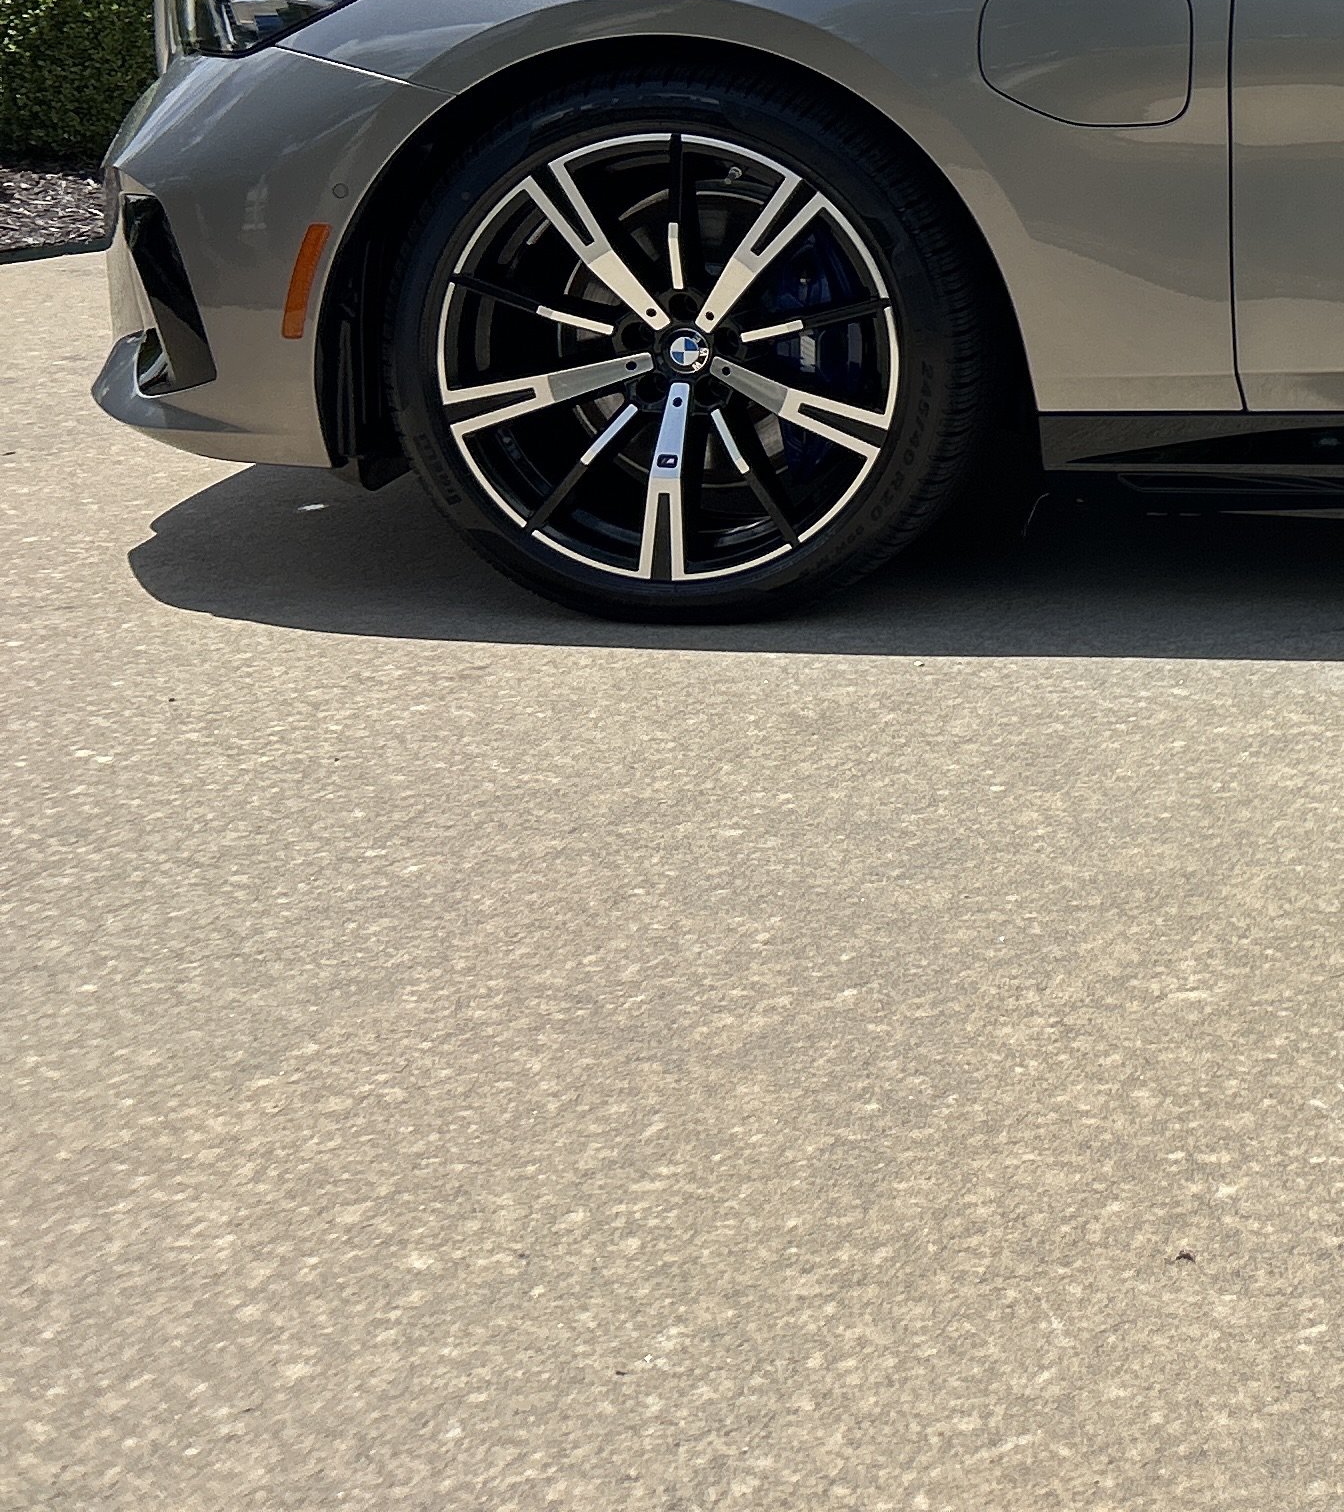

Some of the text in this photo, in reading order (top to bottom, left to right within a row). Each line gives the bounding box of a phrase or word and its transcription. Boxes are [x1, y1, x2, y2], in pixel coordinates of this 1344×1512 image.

[691, 333, 710, 371] BMW
[904, 361, 934, 466] 245/40
[870, 469, 905, 522] R20
